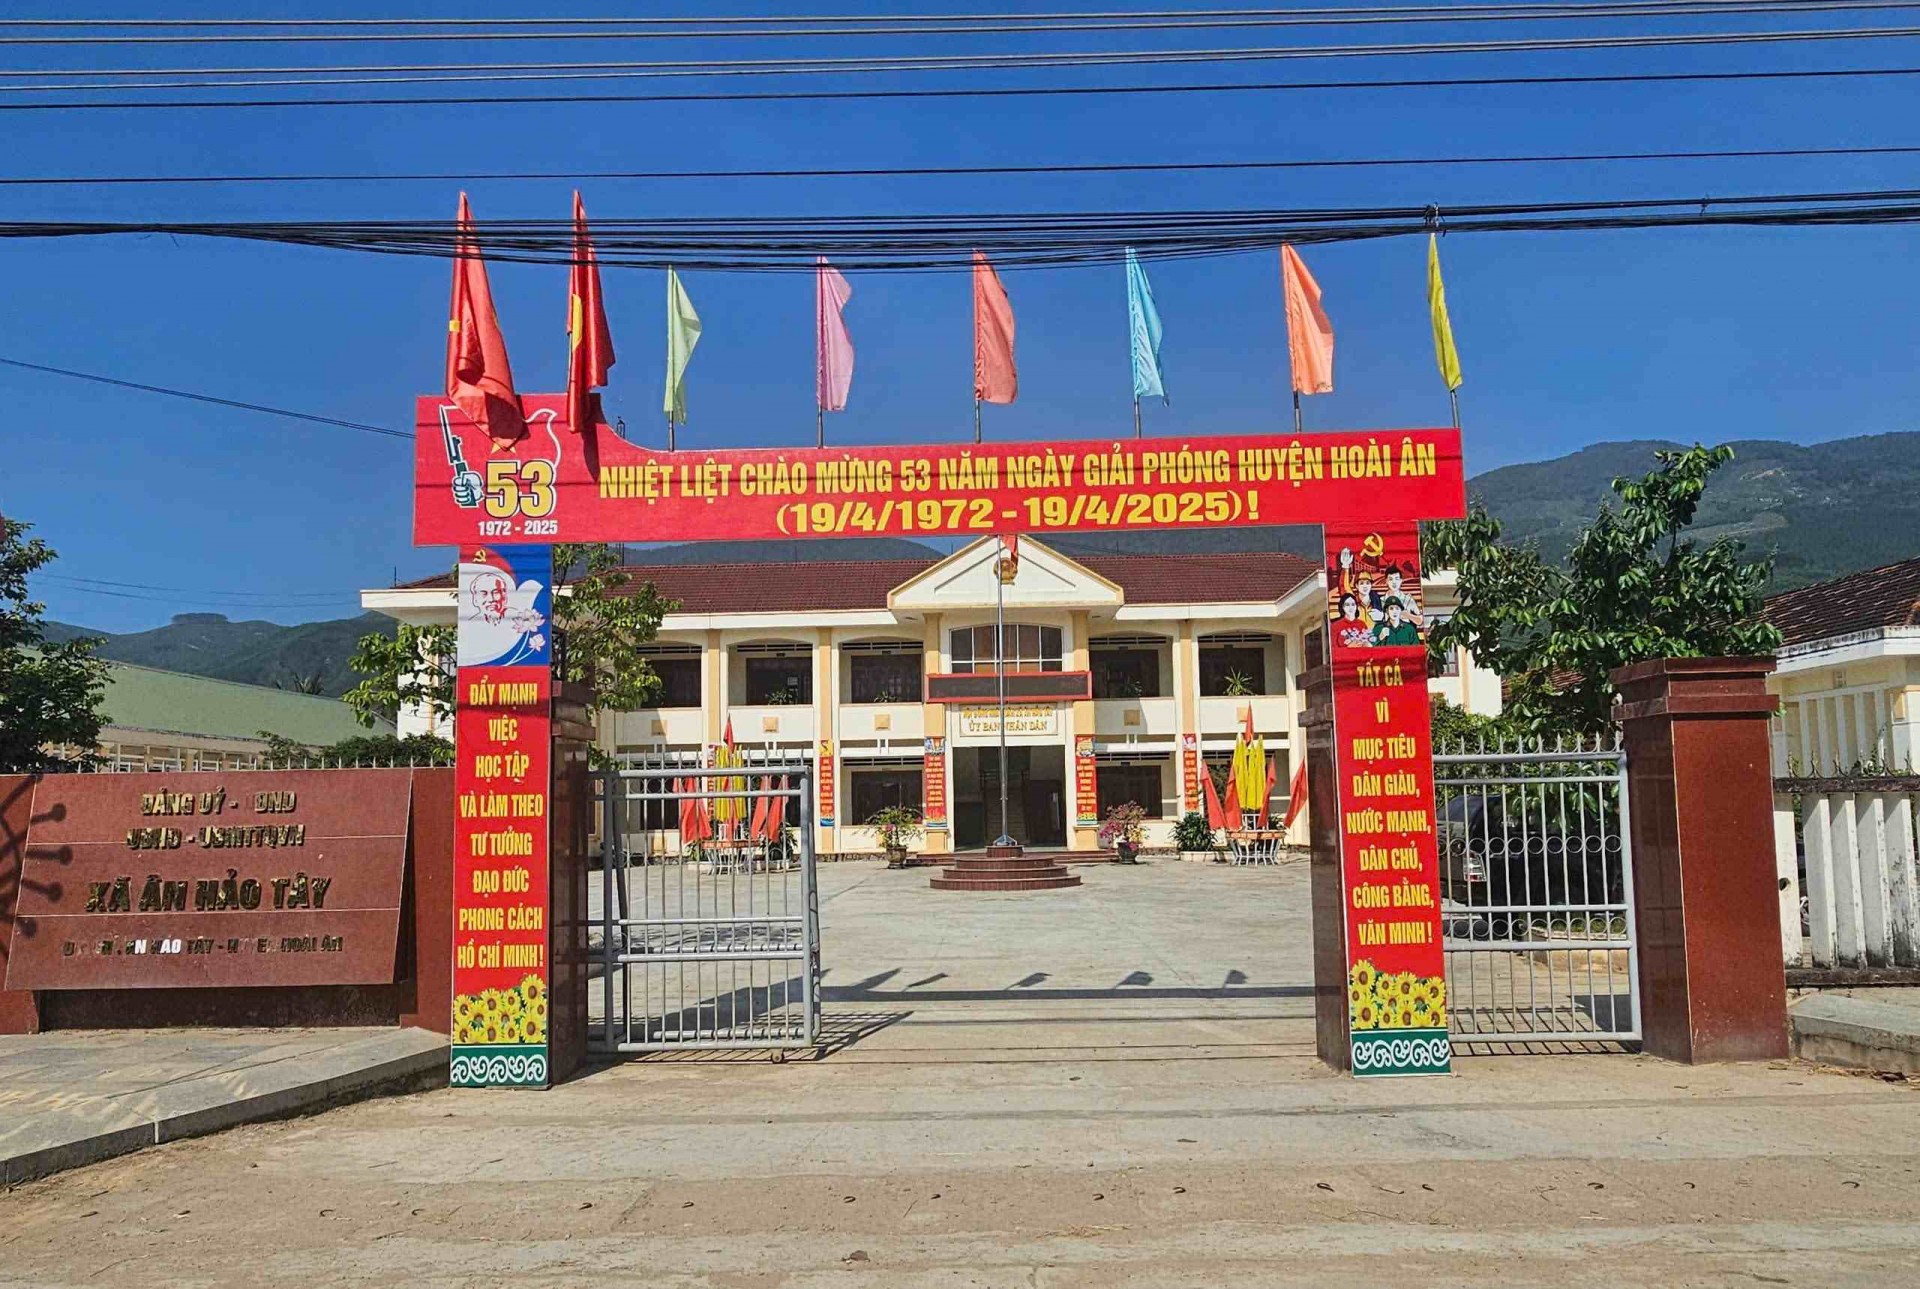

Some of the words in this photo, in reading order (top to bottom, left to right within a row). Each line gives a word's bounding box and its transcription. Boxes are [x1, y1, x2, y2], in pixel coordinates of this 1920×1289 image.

[600, 459, 673, 505] NHIỆT
[681, 458, 733, 505] LIỆT
[740, 459, 807, 497] CHÀO
[816, 455, 892, 493] MỪNG
[900, 464, 930, 491] 53
[939, 450, 999, 490] NĂM
[1006, 447, 1076, 488] NGÀY
[1084, 442, 1135, 486] GIẢI
[1143, 444, 1230, 485] PHÓNG
[1238, 440, 1322, 488] HUYỆN
[1331, 438, 1391, 480] HOÀI
[1400, 437, 1436, 477] ÂN
[485, 460, 557, 518] 53
[478, 520, 510, 536] 1972
[524, 519, 558, 536] 2025
[776, 499, 994, 535] (19/4/1972
[1002, 512, 1017, 520] -
[1357, 658, 1381, 687] TẤT
[1384, 658, 1403, 687] CẢ
[470, 675, 495, 705] ĐẨY
[499, 683, 538, 710] MẠNH
[1375, 697, 1390, 723] VÌ
[489, 714, 518, 746] VIỆC
[1353, 738, 1383, 765] MỤC
[1387, 733, 1416, 759] TIÊU
[475, 755, 501, 783] HỌC
[505, 750, 529, 784] TẬP
[1353, 771, 1381, 797] DÂN
[1384, 770, 1420, 798] GIÀU,
[141, 785, 195, 815] ĐẢNG
[460, 790, 477, 817] VÀ
[480, 790, 508, 817] LÀM
[511, 794, 544, 817] THEO
[1346, 807, 1383, 834] NƯỚC
[1386, 810, 1431, 837] MẠNH,
[471, 831, 488, 856] TƯ
[490, 825, 533, 856] TƯỞNG
[1359, 845, 1388, 871] DÂN
[1391, 840, 1423, 872] CHỦ,
[84, 875, 132, 913] XÃ
[138, 874, 188, 912] ÂN
[195, 868, 262, 911] HẢO
[271, 872, 332, 909] TÂY
[473, 870, 499, 898] ĐẠO
[503, 865, 529, 893] ĐỨC
[1353, 882, 1389, 908] CÔNG
[1393, 877, 1434, 908] BẰNG,
[459, 907, 504, 931] PHONG
[507, 902, 543, 930] CÁCH
[1358, 919, 1386, 945] VĂN
[457, 938, 475, 968] HỒ
[478, 941, 501, 968] CHÍ
